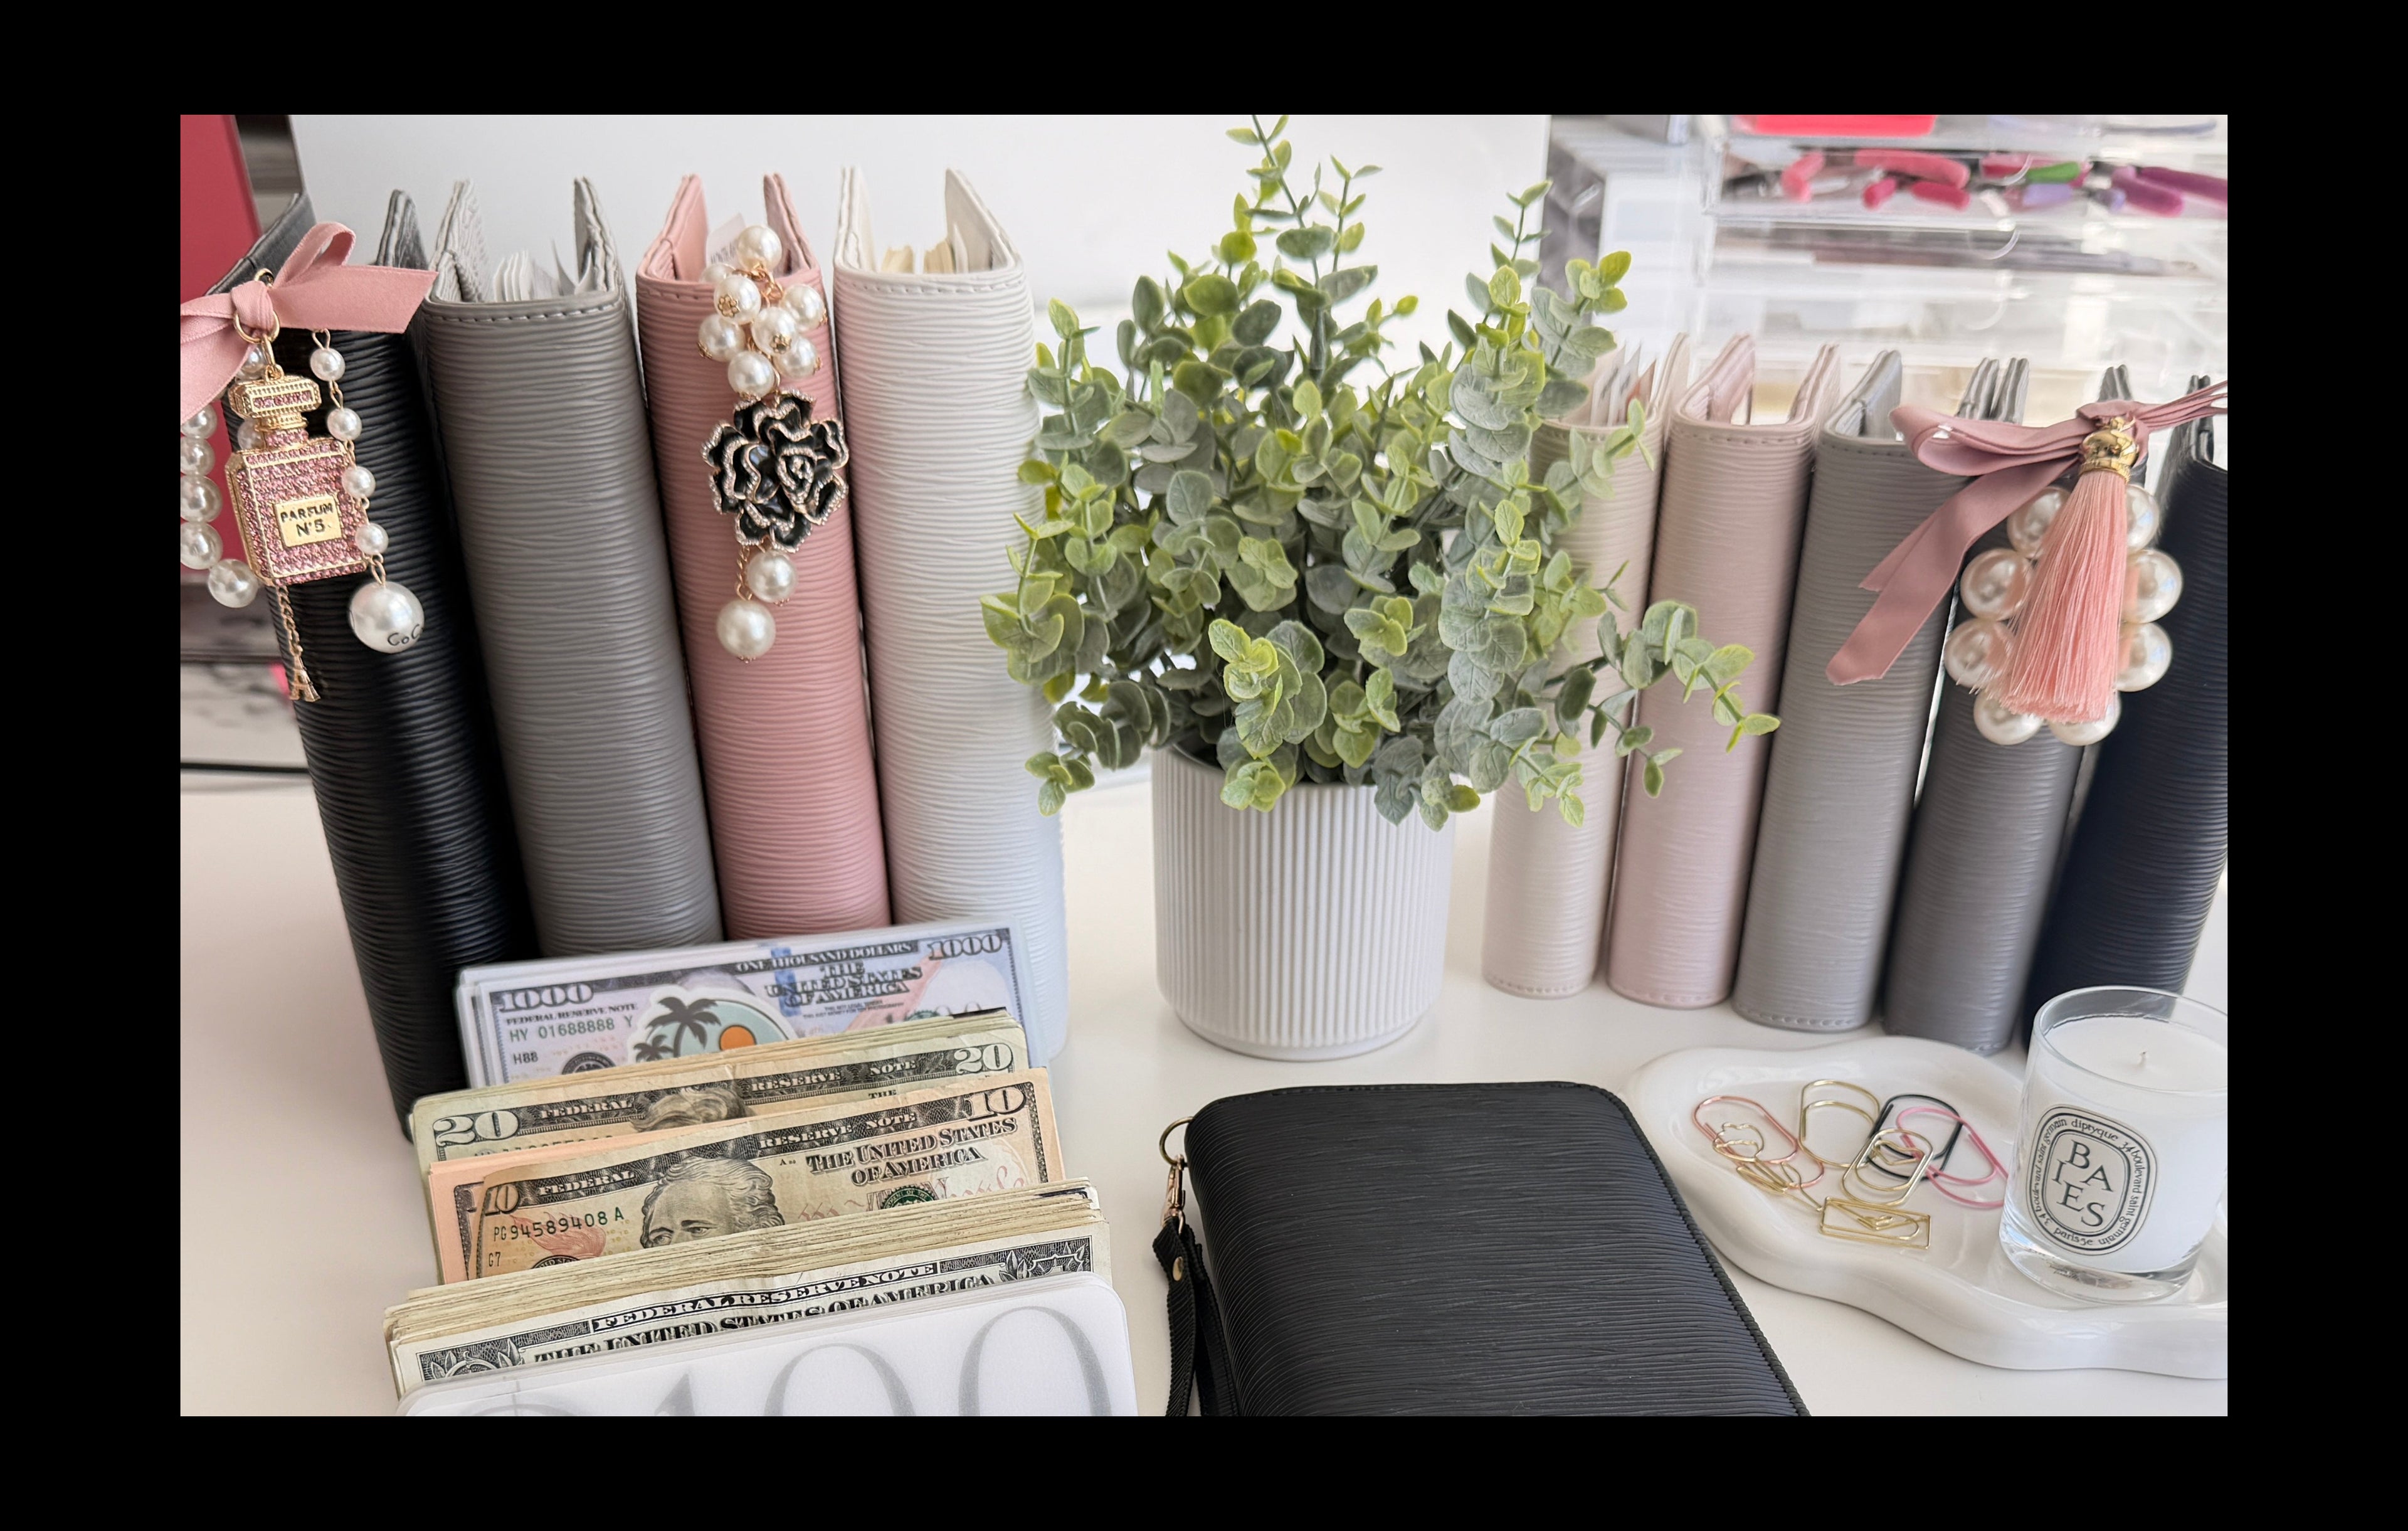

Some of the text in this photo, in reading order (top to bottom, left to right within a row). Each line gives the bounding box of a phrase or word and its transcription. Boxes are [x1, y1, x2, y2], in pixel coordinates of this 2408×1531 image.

[280, 502, 333, 522] PARFUM
[737, 943, 912, 973] ONE THOUSAND DOLLARS
[928, 933, 1003, 961] 1000
[764, 967, 923, 997] UNITED STATES
[820, 960, 865, 979] THE
[499, 983, 594, 1012] 1000
[784, 981, 911, 1007] OF AMERICA
[507, 1003, 638, 1025] FEDERAL RESERVE NOTE
[509, 1015, 633, 1042] HY 01688888 Y
[953, 1043, 1013, 1074] 20
[540, 1060, 917, 1121] FEDERAL RESERVE NOTE
[868, 1088, 897, 1099] THE
[964, 1085, 1027, 1121] 10
[432, 1110, 520, 1147] 20
[2071, 1118, 2119, 1143] diptyque
[538, 1111, 917, 1197] FEDERAL RESERVE NOTE
[805, 1116, 1018, 1175] THE UNITED STATES
[850, 1145, 988, 1187] OF AMERICA
[2131, 1149, 2145, 1194] boulevard
[484, 1183, 520, 1217] 10
[615, 1206, 625, 1221] A
[2126, 1195, 2139, 1216] saint
[2098, 1216, 2131, 1246] germain
[488, 1252, 501, 1267] G7
[596, 1263, 935, 1330] FEDERAL RESERVE NOTE
